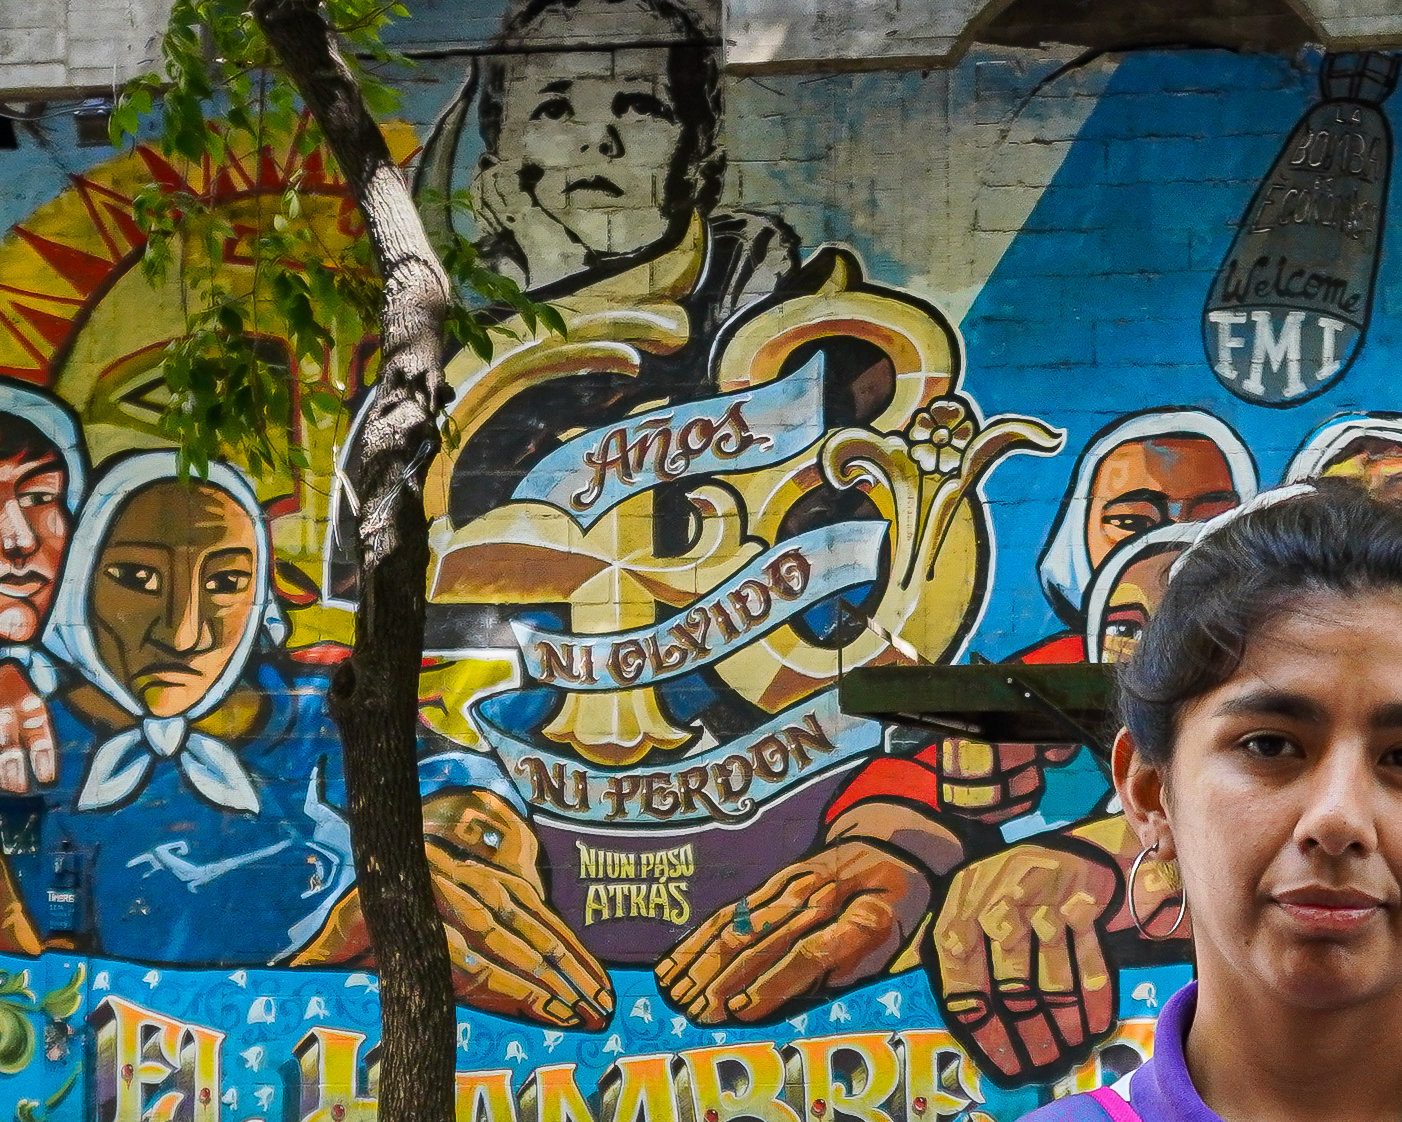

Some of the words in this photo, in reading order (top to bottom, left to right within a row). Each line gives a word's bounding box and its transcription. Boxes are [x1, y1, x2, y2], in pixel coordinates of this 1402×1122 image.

[1213, 256, 1362, 313] Welcome
[1208, 310, 1346, 398] FMI
[534, 640, 600, 685] NI
[605, 545, 814, 686] OLVIDO
[513, 754, 593, 813] NI
[600, 708, 840, 823] PERDON
[640, 843, 695, 878] PASO
